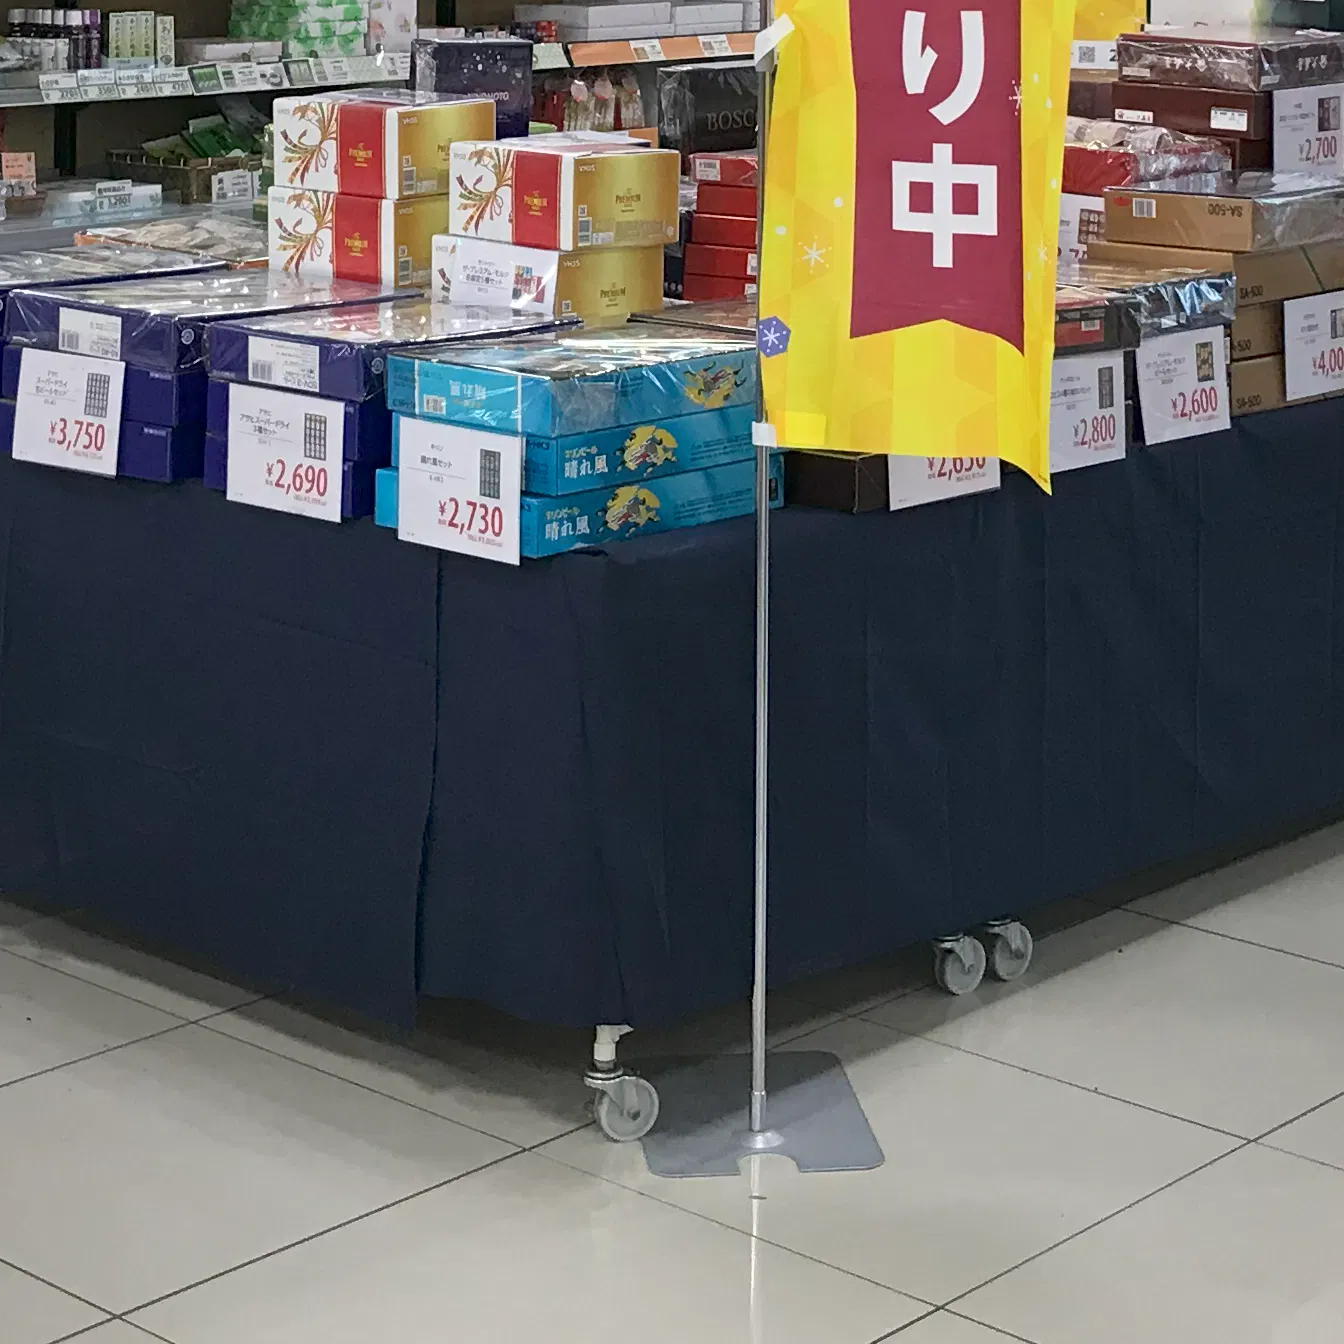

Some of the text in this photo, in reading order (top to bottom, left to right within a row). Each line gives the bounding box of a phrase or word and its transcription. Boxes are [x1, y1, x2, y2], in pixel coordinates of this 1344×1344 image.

[1299, 136, 1337, 165] ¥2,700
[1230, 339, 1251, 352] A-500
[1171, 386, 1218, 421] ¥2,600
[50, 418, 105, 451] ¥3,750
[1073, 413, 1115, 449] ¥2,800
[266, 459, 328, 497] ¥2,690
[564, 455, 608, 479] 晴れ風
[438, 497, 503, 537] ¥2,730
[545, 515, 590, 542] 晴れ風
